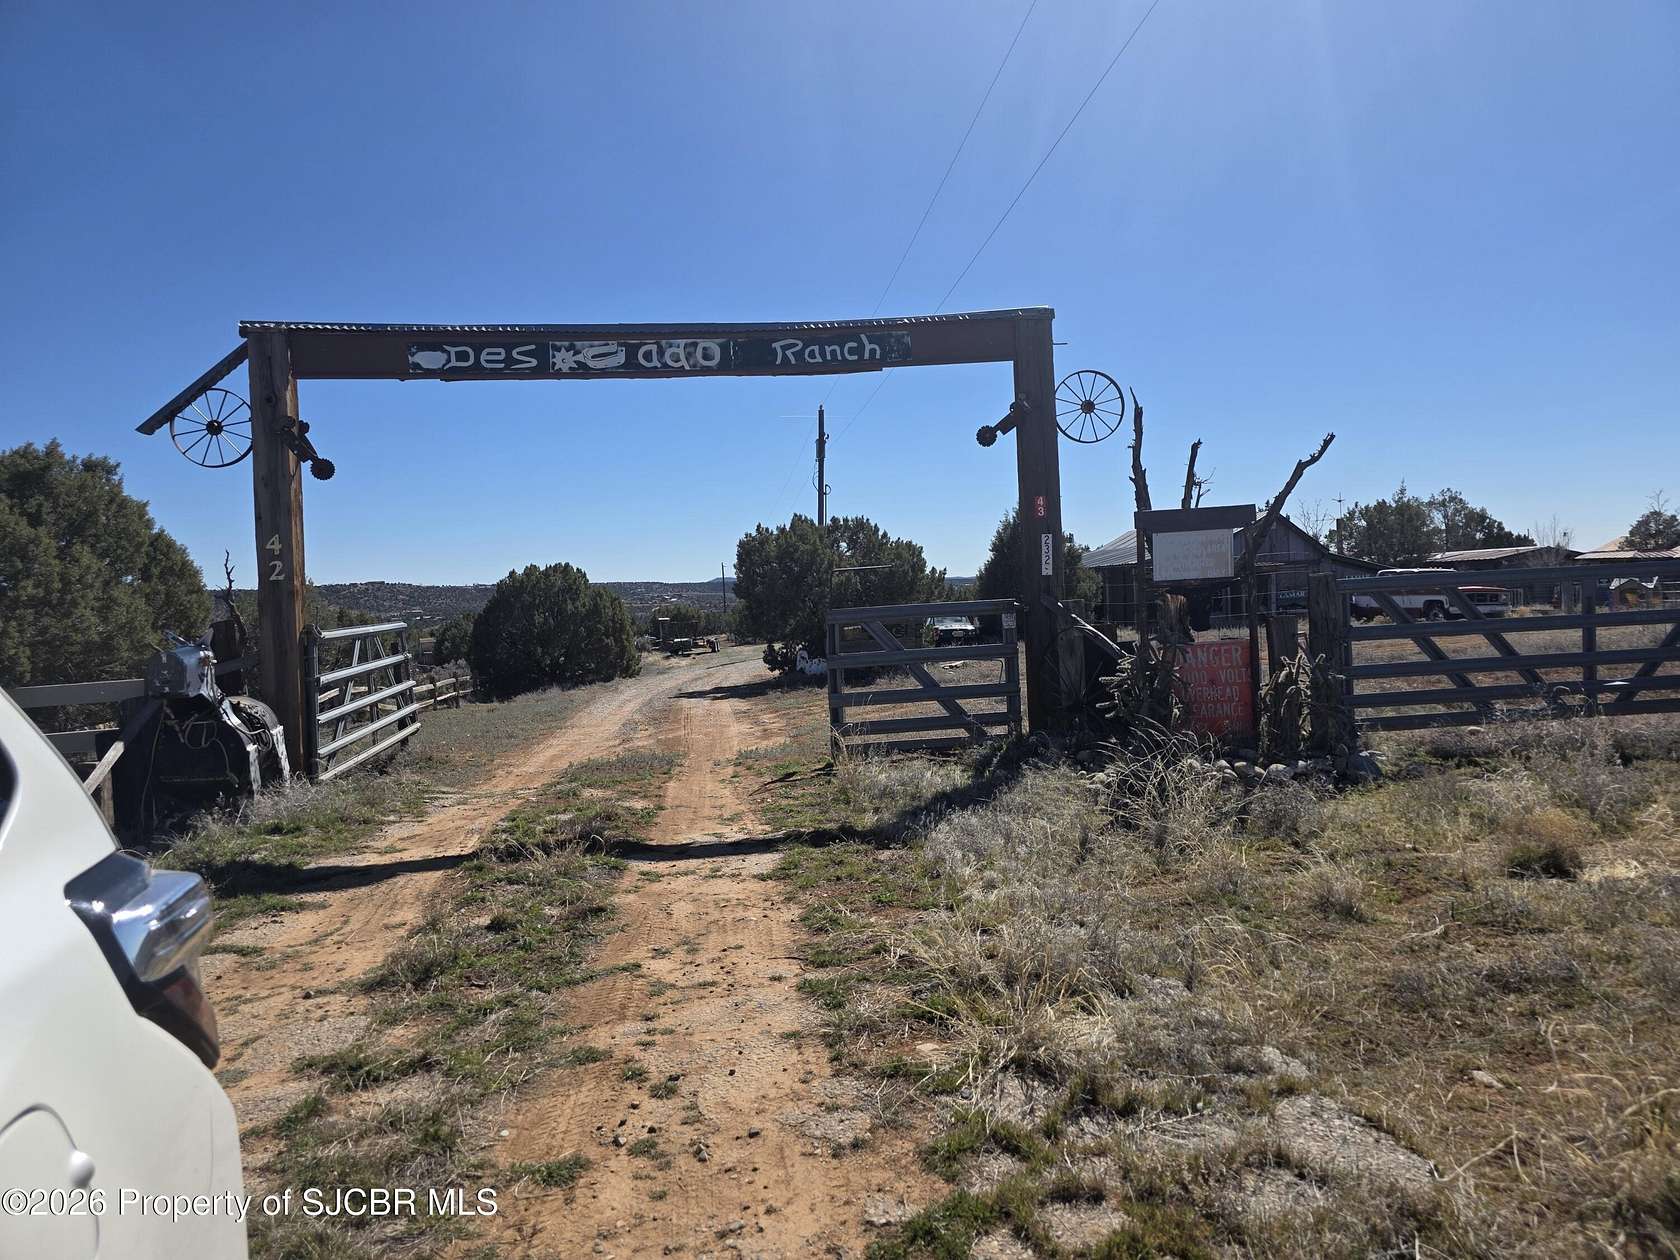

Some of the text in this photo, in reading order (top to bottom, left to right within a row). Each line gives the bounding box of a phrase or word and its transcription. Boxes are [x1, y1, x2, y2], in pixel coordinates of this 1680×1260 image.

[771, 334, 881, 365] Ranch
[1037, 496, 1045, 516] 43
[265, 534, 286, 580] 42
[1181, 643, 1242, 667] ANGER
